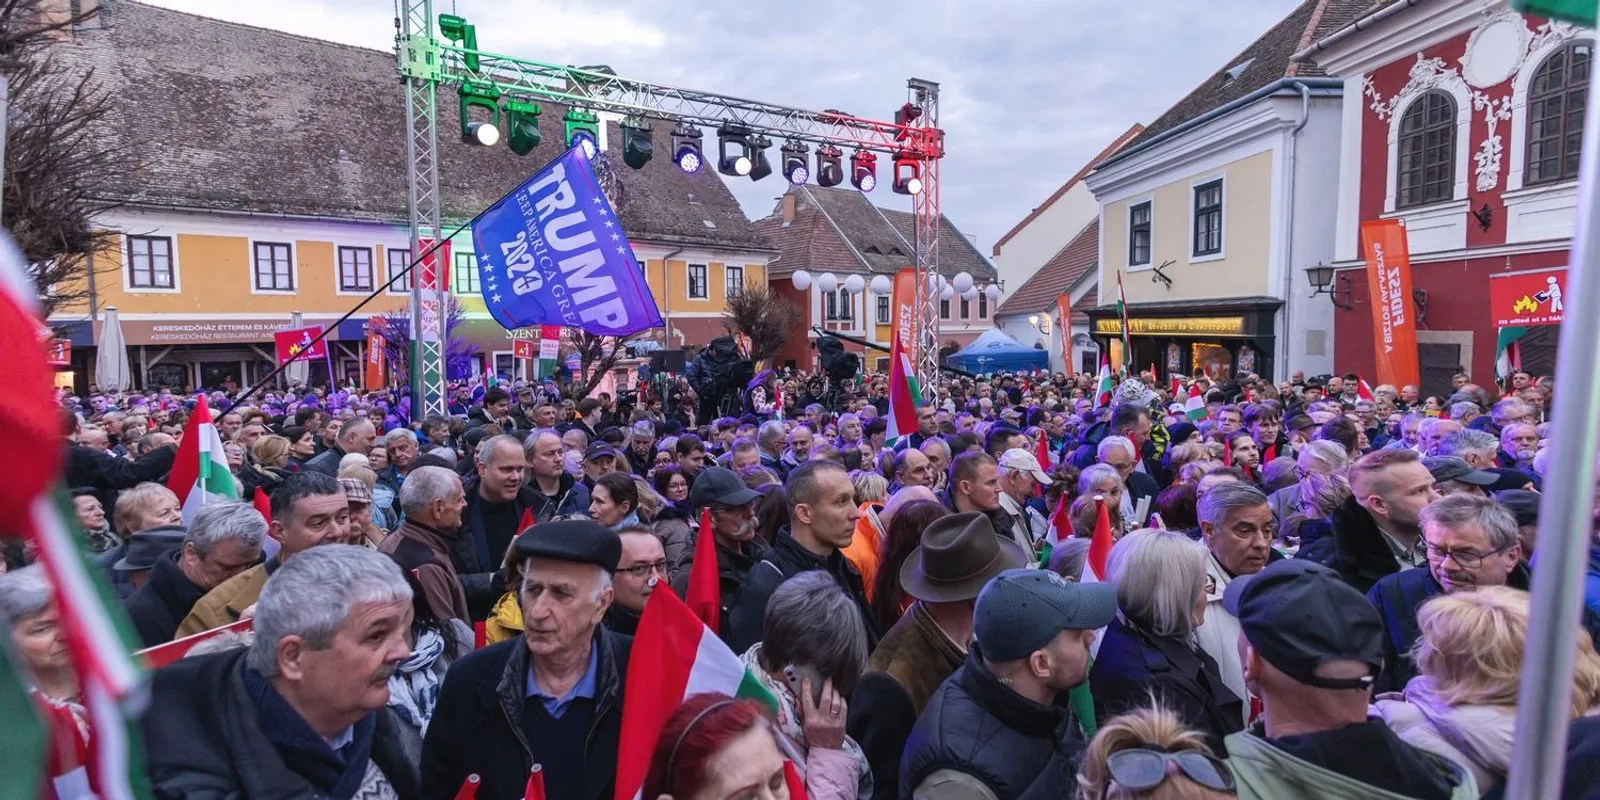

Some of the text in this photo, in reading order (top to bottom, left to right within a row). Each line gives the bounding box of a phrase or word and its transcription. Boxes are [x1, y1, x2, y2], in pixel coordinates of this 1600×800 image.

[525, 217, 557, 282] AMERICA
[528, 163, 629, 329] TRUMP
[900, 303, 912, 349] FIDESZ
[1098, 319, 1145, 332] KARNVÁL
